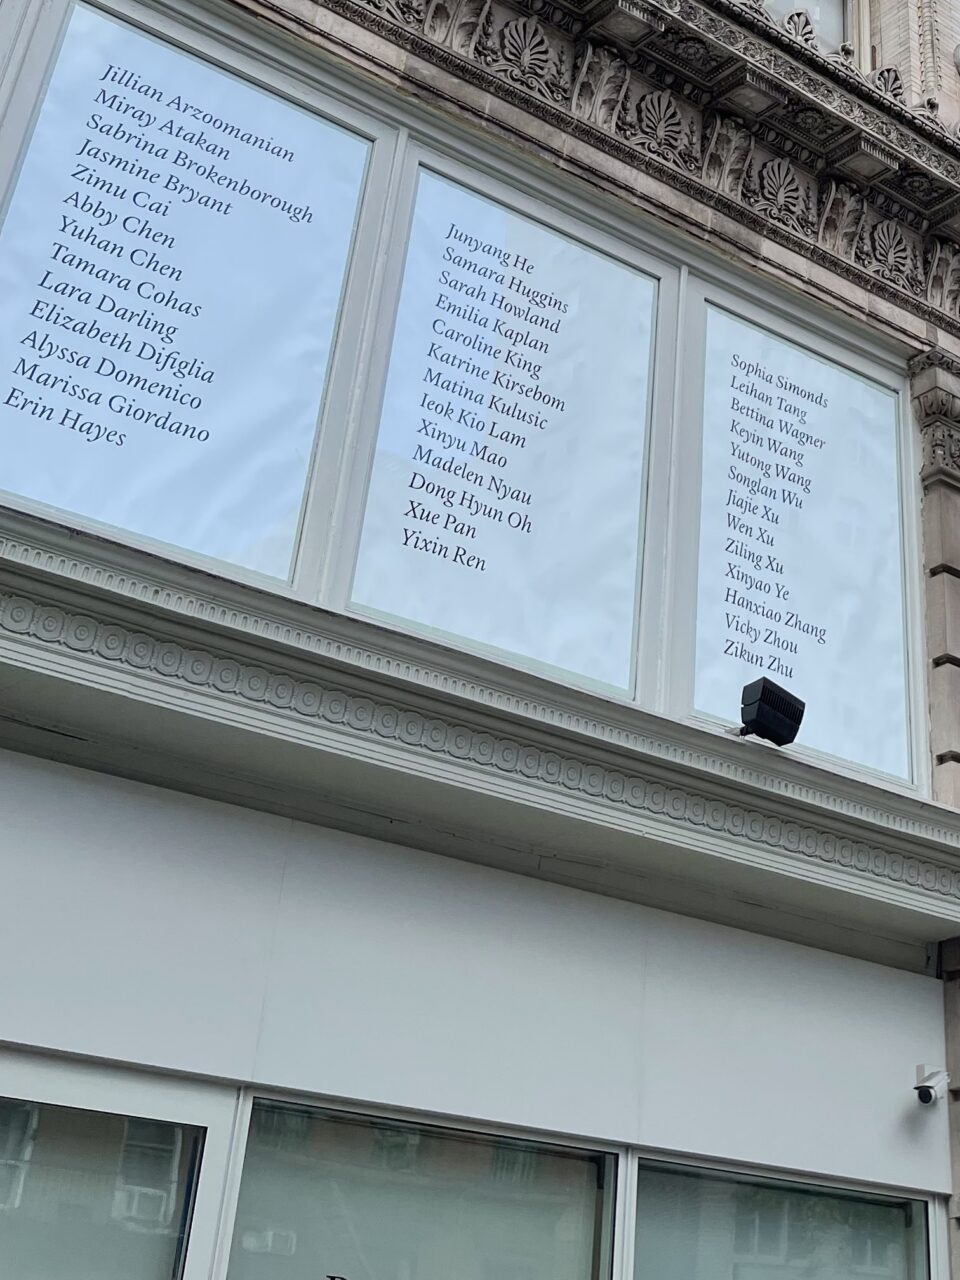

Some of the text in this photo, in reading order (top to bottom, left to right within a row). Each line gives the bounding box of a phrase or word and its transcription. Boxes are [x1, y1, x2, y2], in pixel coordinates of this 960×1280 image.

[93, 88, 230, 160] Miray Atakan
[99, 64, 294, 162] Jillian Arzoomanian
[71, 164, 172, 216] Zimu Cai
[75, 139, 233, 215] Jasmine Bryant
[86, 114, 312, 223] Sabrina Brokenborough
[59, 215, 182, 281] Yuhan Chen
[62, 192, 175, 248] Abby Chen
[445, 223, 534, 274] Junyang He
[37, 270, 179, 344] Lara Darling
[50, 242, 202, 317] Tamara Cohas
[439, 271, 561, 333] Sarah Howland
[443, 247, 568, 313] Samara Huggins
[29, 299, 214, 383] Elizabeth Difiglia
[433, 319, 542, 380] Caroline King
[435, 293, 548, 354] Emilia Kaplan
[20, 331, 201, 409] Alyssa Domenico
[427, 342, 564, 412] Katrine Kirsebom
[731, 354, 828, 408] Sophia Simonds
[3, 387, 126, 446] Erin Hayes
[12, 357, 209, 441] Marissa Giordano
[420, 393, 526, 448] Ieok Kio Lam
[423, 368, 548, 430] Matina Kulusic
[730, 375, 807, 424] Leihan Tang
[731, 397, 826, 449] Bettina Wagner
[417, 418, 507, 467] Xinyu Mao
[730, 419, 804, 467] Keyin Wang
[731, 441, 811, 494] Yutong Wang
[408, 472, 531, 533] Dong Hyun Oh
[412, 444, 531, 505] Madelen Nyau
[728, 465, 802, 509] Songlan Wu
[403, 500, 476, 539] Xue Pan
[726, 489, 779, 524] Jiajie Xu
[728, 513, 774, 546] Wen Xu
[402, 528, 485, 571] Yixin Ren
[725, 538, 784, 574] Ziling Xu
[725, 562, 789, 600] Xinyao Ye
[724, 587, 826, 644] Hanxiao Zhang
[726, 612, 797, 654] Vicky Zhou
[724, 639, 793, 678] Zikun Zhu
